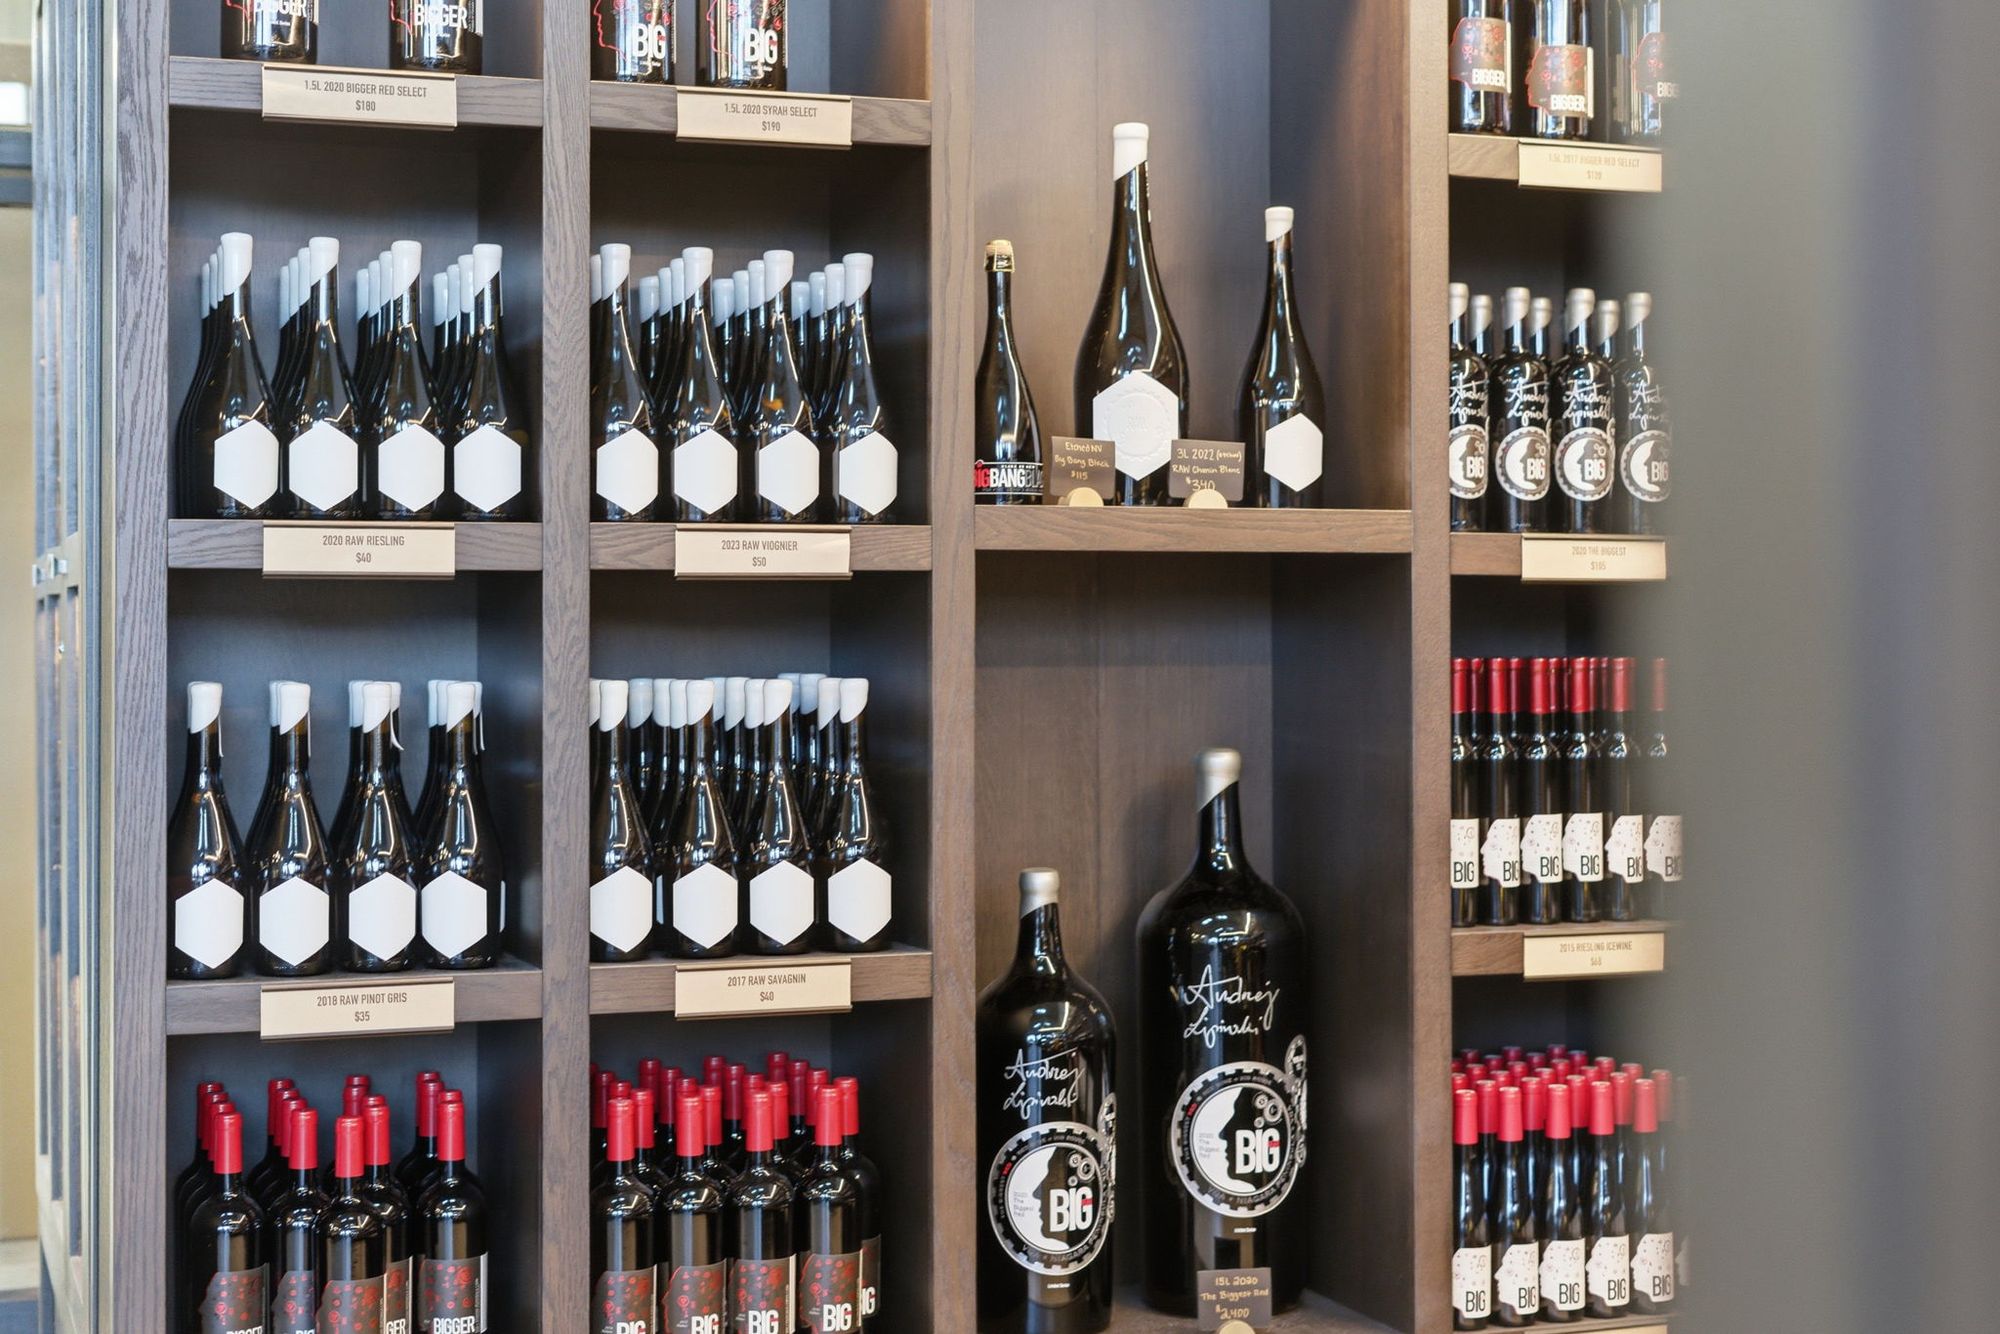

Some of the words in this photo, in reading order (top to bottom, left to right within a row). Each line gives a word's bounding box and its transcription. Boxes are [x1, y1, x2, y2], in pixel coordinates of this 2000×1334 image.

[631, 23, 667, 60] BIG
[744, 28, 778, 64] BIG
[1472, 68, 1506, 87] BIGGER
[304, 80, 322, 91] 1.5L
[324, 81, 344, 92] 2020
[346, 82, 376, 94] BIGGER
[378, 84, 395, 96] RED
[397, 85, 427, 98] SELECT
[356, 100, 376, 112] $180
[724, 104, 740, 113] 1.5L
[742, 104, 761, 114] 2020
[762, 105, 788, 116] SYRAH
[790, 106, 817, 118] SELECT
[1550, 94, 1586, 112] BIGGER
[762, 121, 781, 132] $190
[1617, 158, 1640, 168] SELECT
[1177, 448, 1189, 459] 3L
[1192, 449, 1214, 460] 2022
[1172, 464, 1190, 473] RAW
[1466, 456, 1484, 478] BIG
[1526, 458, 1546, 480] BIG
[1584, 459, 1606, 480] BIG
[1652, 461, 1669, 482] BIG
[323, 535, 343, 546] 2020
[345, 535, 364, 545] RAW
[367, 535, 404, 546] RIESLING
[721, 540, 740, 550] 2023
[742, 540, 759, 550] RAW
[763, 540, 798, 551] VIOGNIER
[356, 552, 371, 563] $40
[752, 557, 766, 567] $50
[1453, 861, 1474, 882] BIG
[1540, 856, 1559, 877] BIG
[1580, 855, 1600, 875] BIG
[1665, 856, 1682, 876] BIG
[1606, 940, 1632, 951] ICEWINE
[728, 976, 746, 987] 2017
[748, 975, 765, 986] RAW
[768, 973, 806, 984] SAVAGNIN
[317, 996, 337, 1006] 2018
[340, 994, 359, 1005] RAW
[361, 993, 385, 1004] PINOT
[387, 992, 407, 1003] GRIS
[760, 992, 774, 1002] $40
[355, 1011, 370, 1022] $35
[1236, 1128, 1280, 1174] BIG
[1050, 1186, 1093, 1232] BIG
[1233, 1276, 1258, 1285] 2020
[1608, 1279, 1626, 1300] BIG
[1653, 1274, 1671, 1296] BIG
[862, 1287, 876, 1315] IG
[1465, 1290, 1485, 1312] BIG
[1518, 1286, 1536, 1308] BIG
[1559, 1283, 1580, 1305] BIG
[433, 1316, 475, 1334] BIGGER
[748, 1310, 778, 1334] BIG
[823, 1303, 852, 1332] BIG
